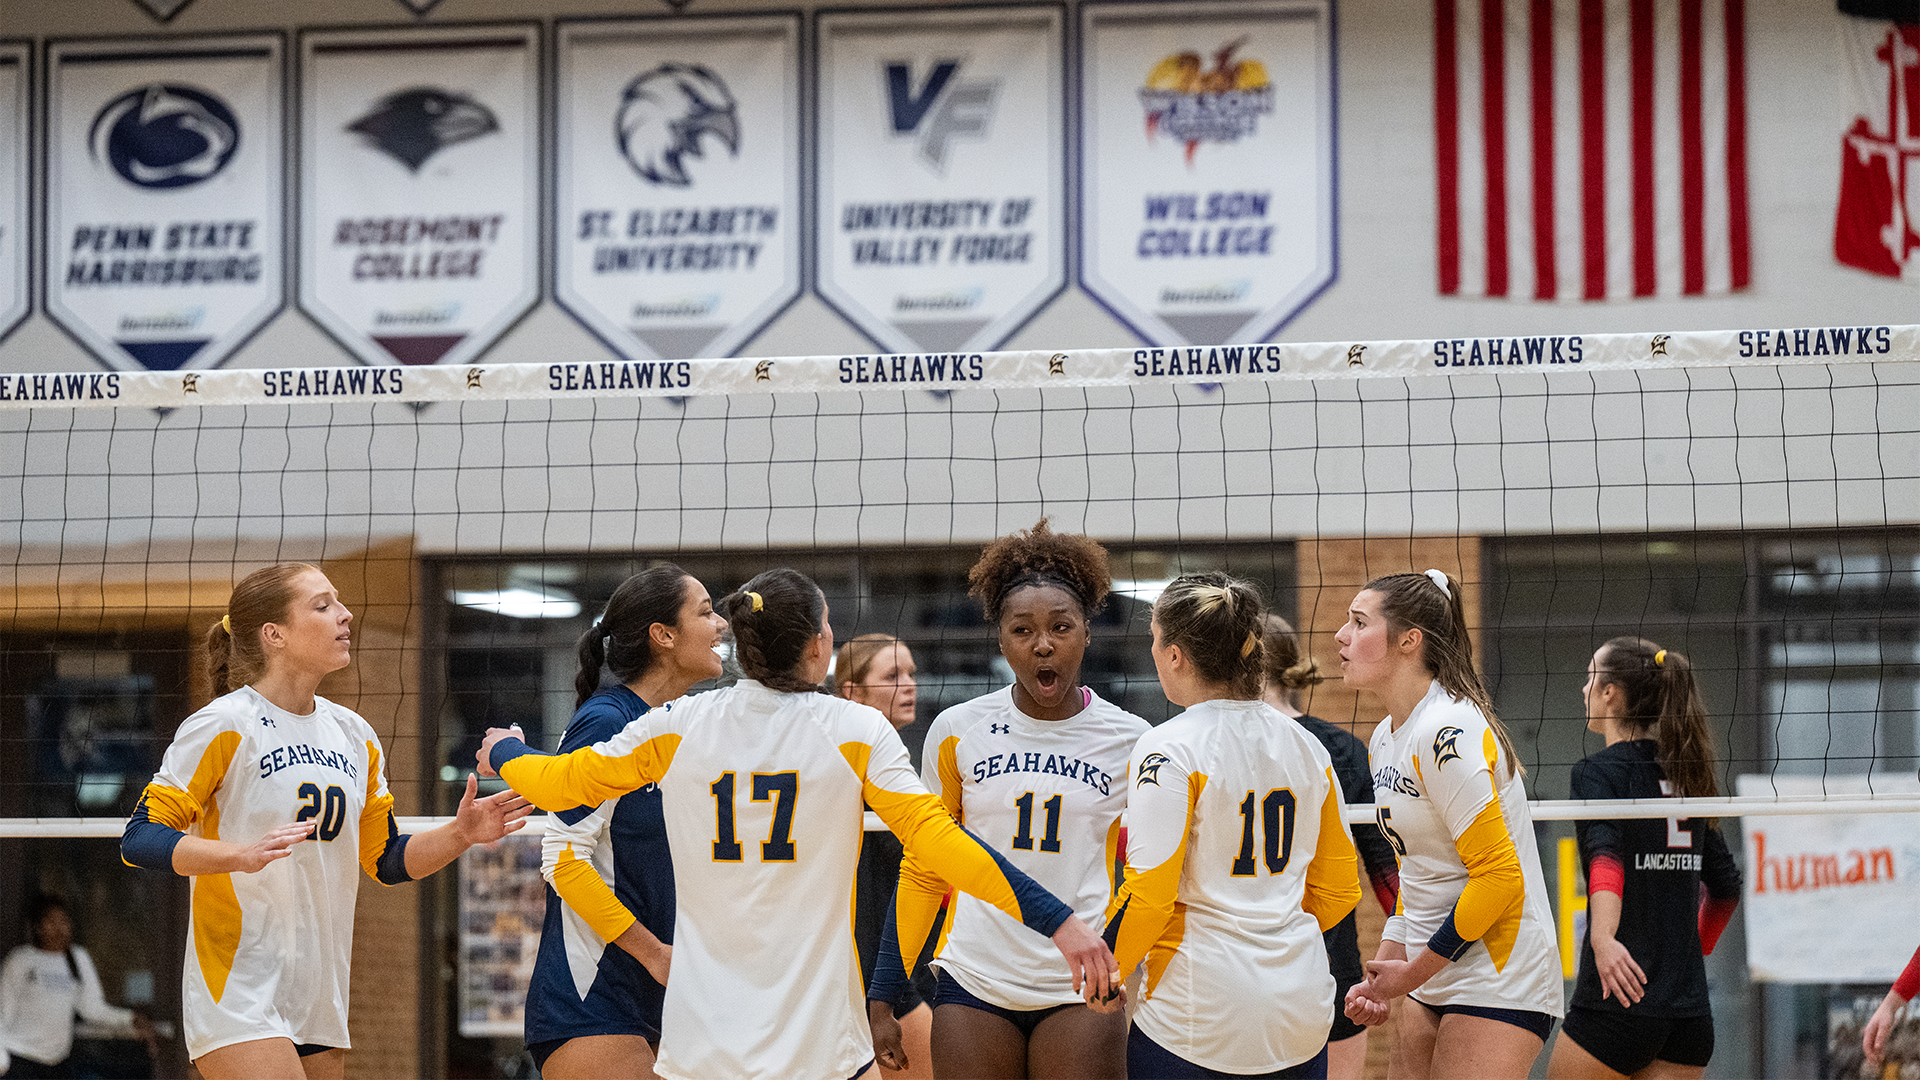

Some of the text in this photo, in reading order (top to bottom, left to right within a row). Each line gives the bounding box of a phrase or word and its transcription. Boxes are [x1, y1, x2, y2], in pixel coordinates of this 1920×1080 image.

[627, 206, 777, 238] ELIZABETH
[842, 199, 1032, 233] UNIVERSITY OF
[1146, 193, 1271, 221] WILSON
[73, 221, 256, 251] PENN STATE
[334, 215, 503, 246] ROSEMONT
[1137, 226, 1275, 258] COLLEGE
[593, 243, 763, 275] UNIVERSITY
[852, 233, 1032, 266] VALLEY FORGE
[66, 256, 262, 287] HARRISBURG
[352, 251, 485, 282] COLLEGE
[1434, 336, 1583, 368] SEAHAWKS
[1739, 327, 1891, 358] SEAHAWKS
[549, 362, 691, 391] SEAHAWKS
[839, 355, 984, 384] SEAHAWKS
[1134, 346, 1281, 377] SEAHAWKS
[0, 374, 119, 400] EAHAWKS
[263, 368, 403, 397] SEAHAWKS
[973, 752, 1112, 796] SEAHAWKS
[295, 781, 347, 843] 20
[709, 770, 800, 863] 17
[1011, 790, 1063, 854] 11
[1230, 787, 1297, 877] 10
[1635, 853, 1693, 871] LANCASTER
[1752, 829, 1894, 895] human
